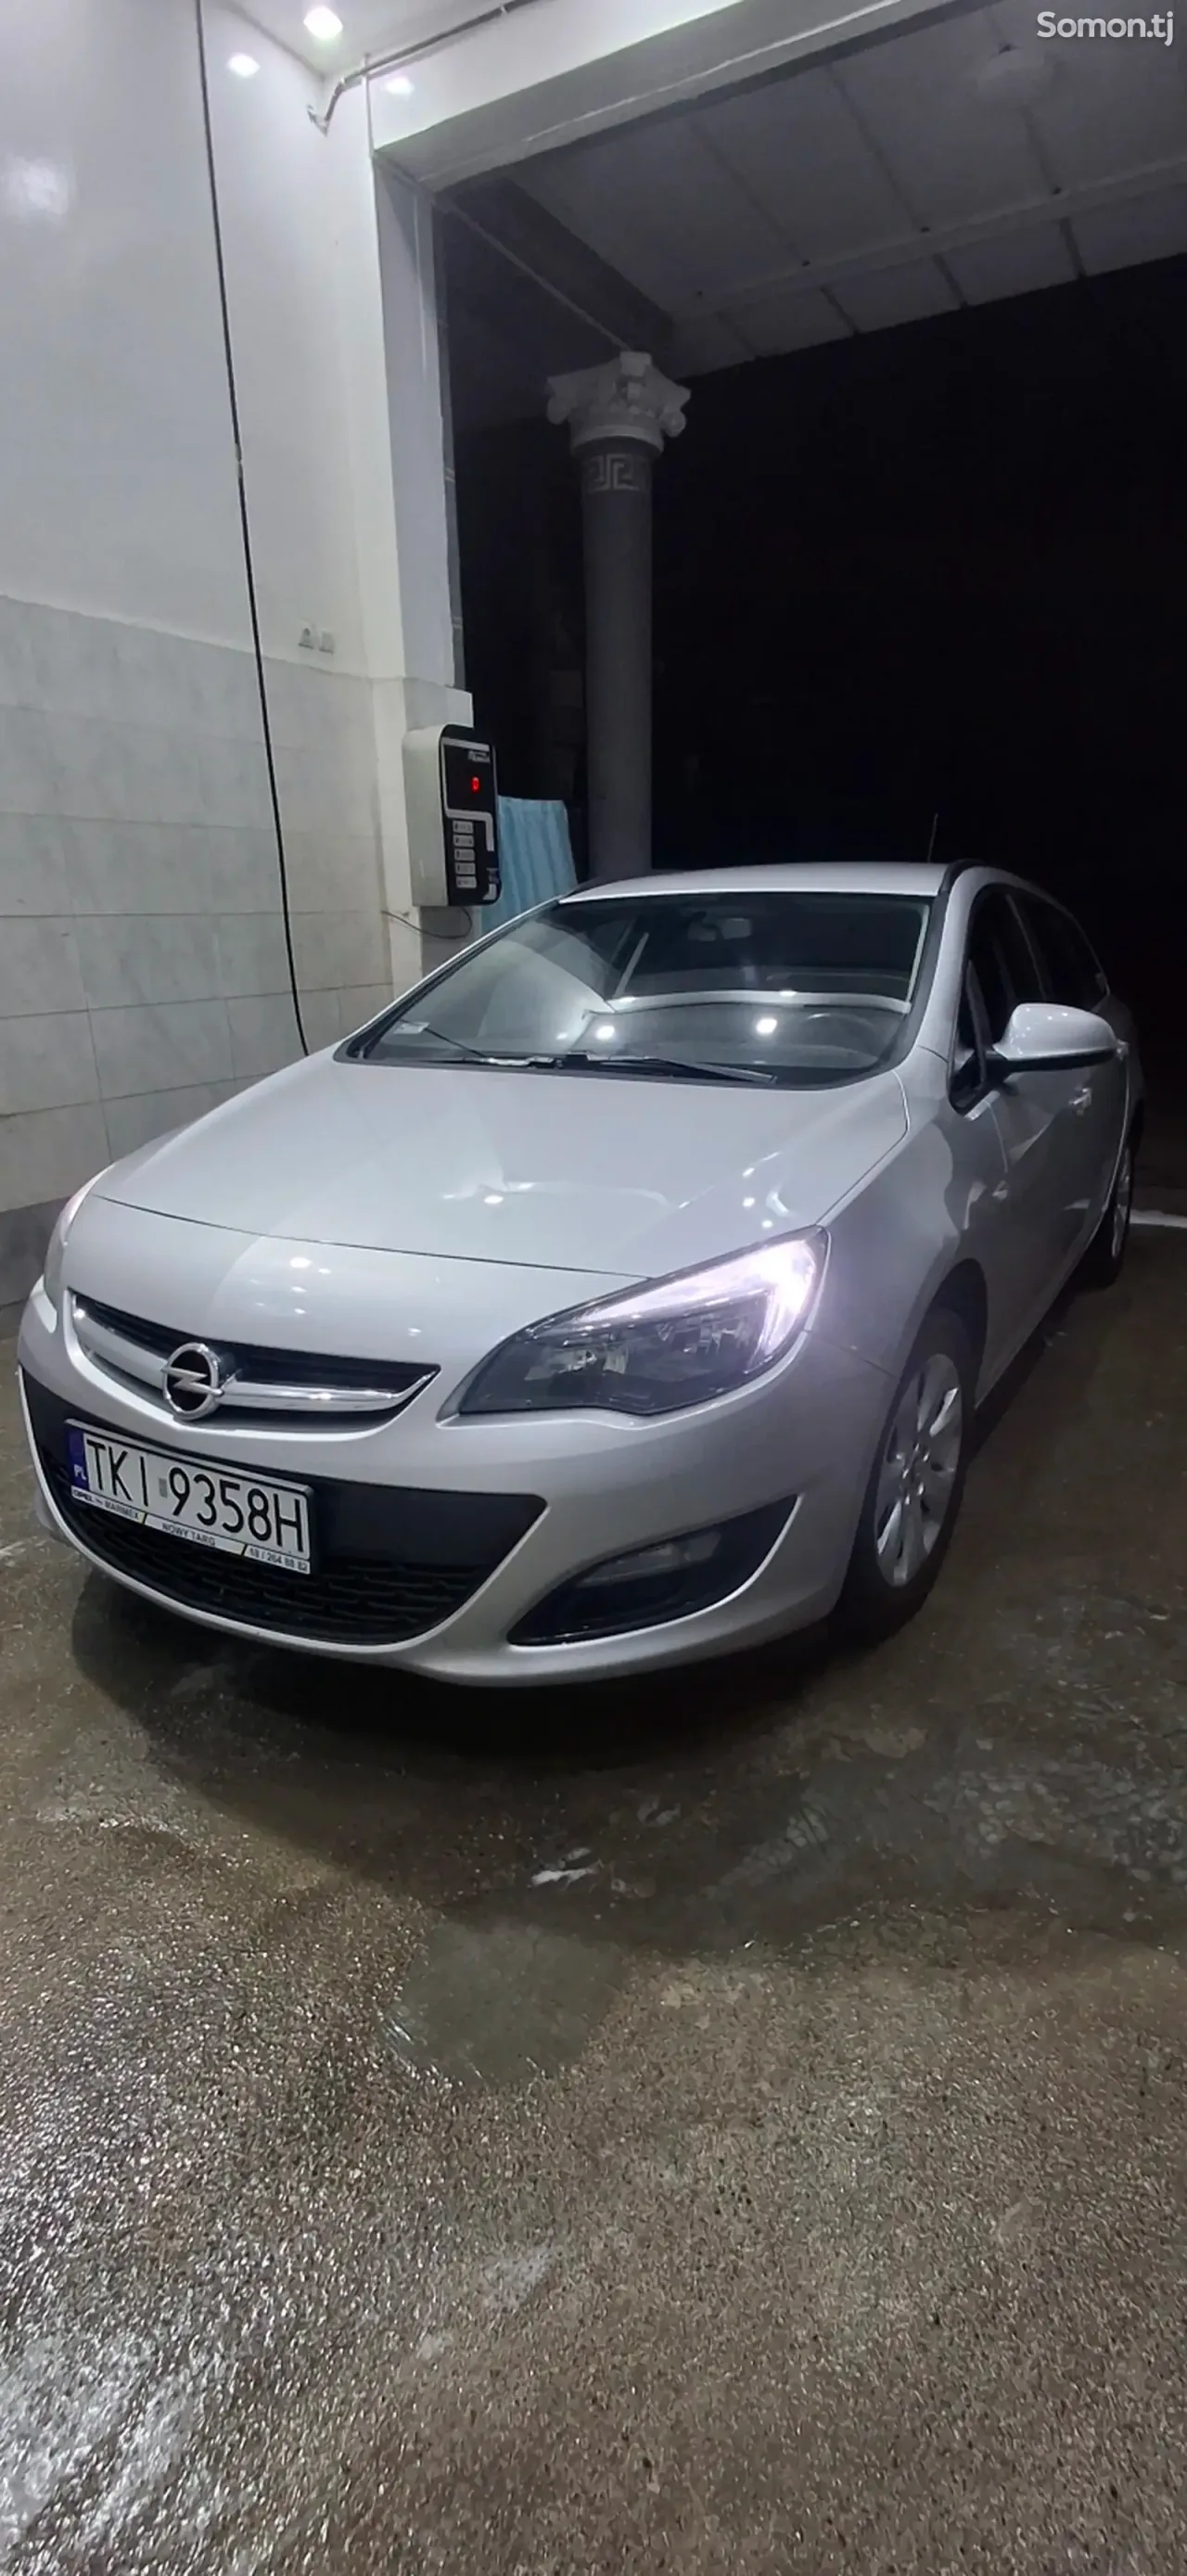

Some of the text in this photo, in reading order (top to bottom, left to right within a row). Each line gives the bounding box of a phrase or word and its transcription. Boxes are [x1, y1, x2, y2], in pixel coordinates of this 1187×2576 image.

[73, 1462, 87, 1481] PL
[86, 1438, 304, 1553] TKI 9358H
